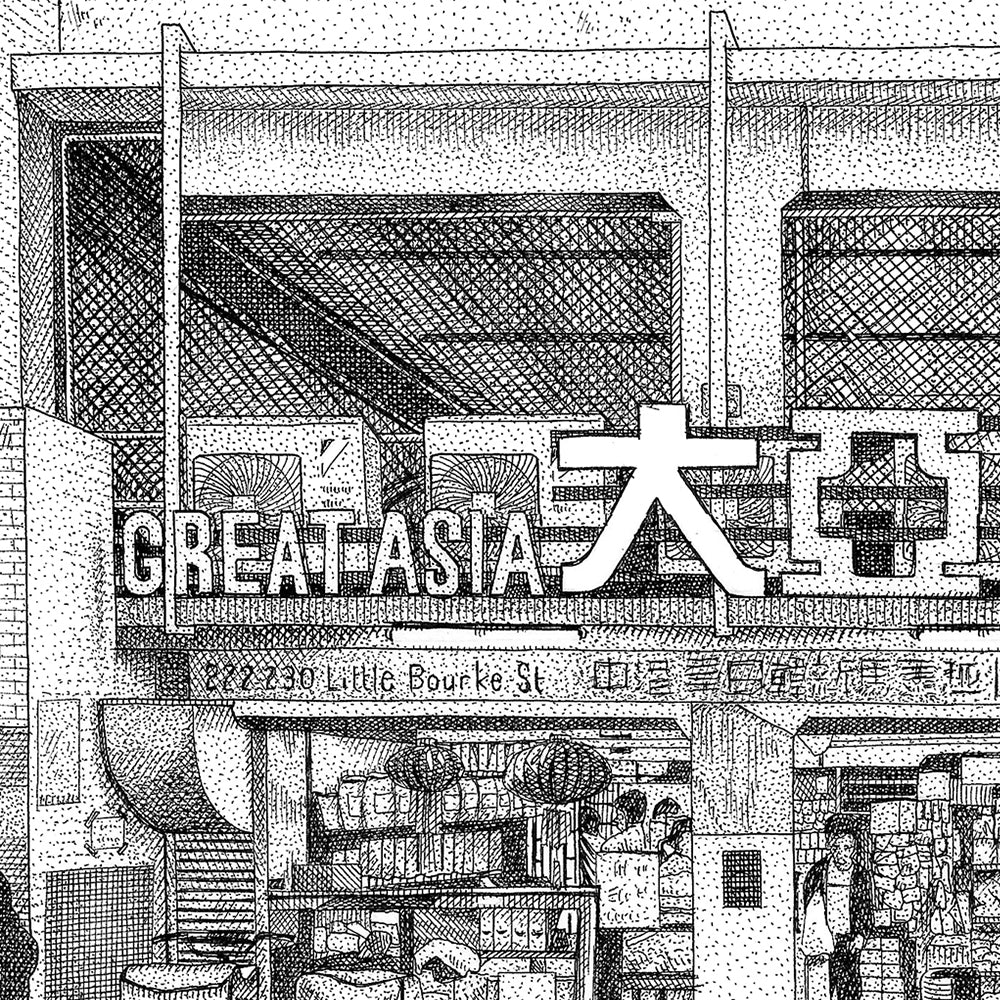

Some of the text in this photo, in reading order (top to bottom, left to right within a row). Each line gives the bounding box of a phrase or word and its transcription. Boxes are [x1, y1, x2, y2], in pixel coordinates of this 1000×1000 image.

[122, 508, 547, 596] GREAT ASIA
[326, 662, 395, 692] Little
[409, 662, 503, 692] Bourke
[516, 660, 546, 694] St
